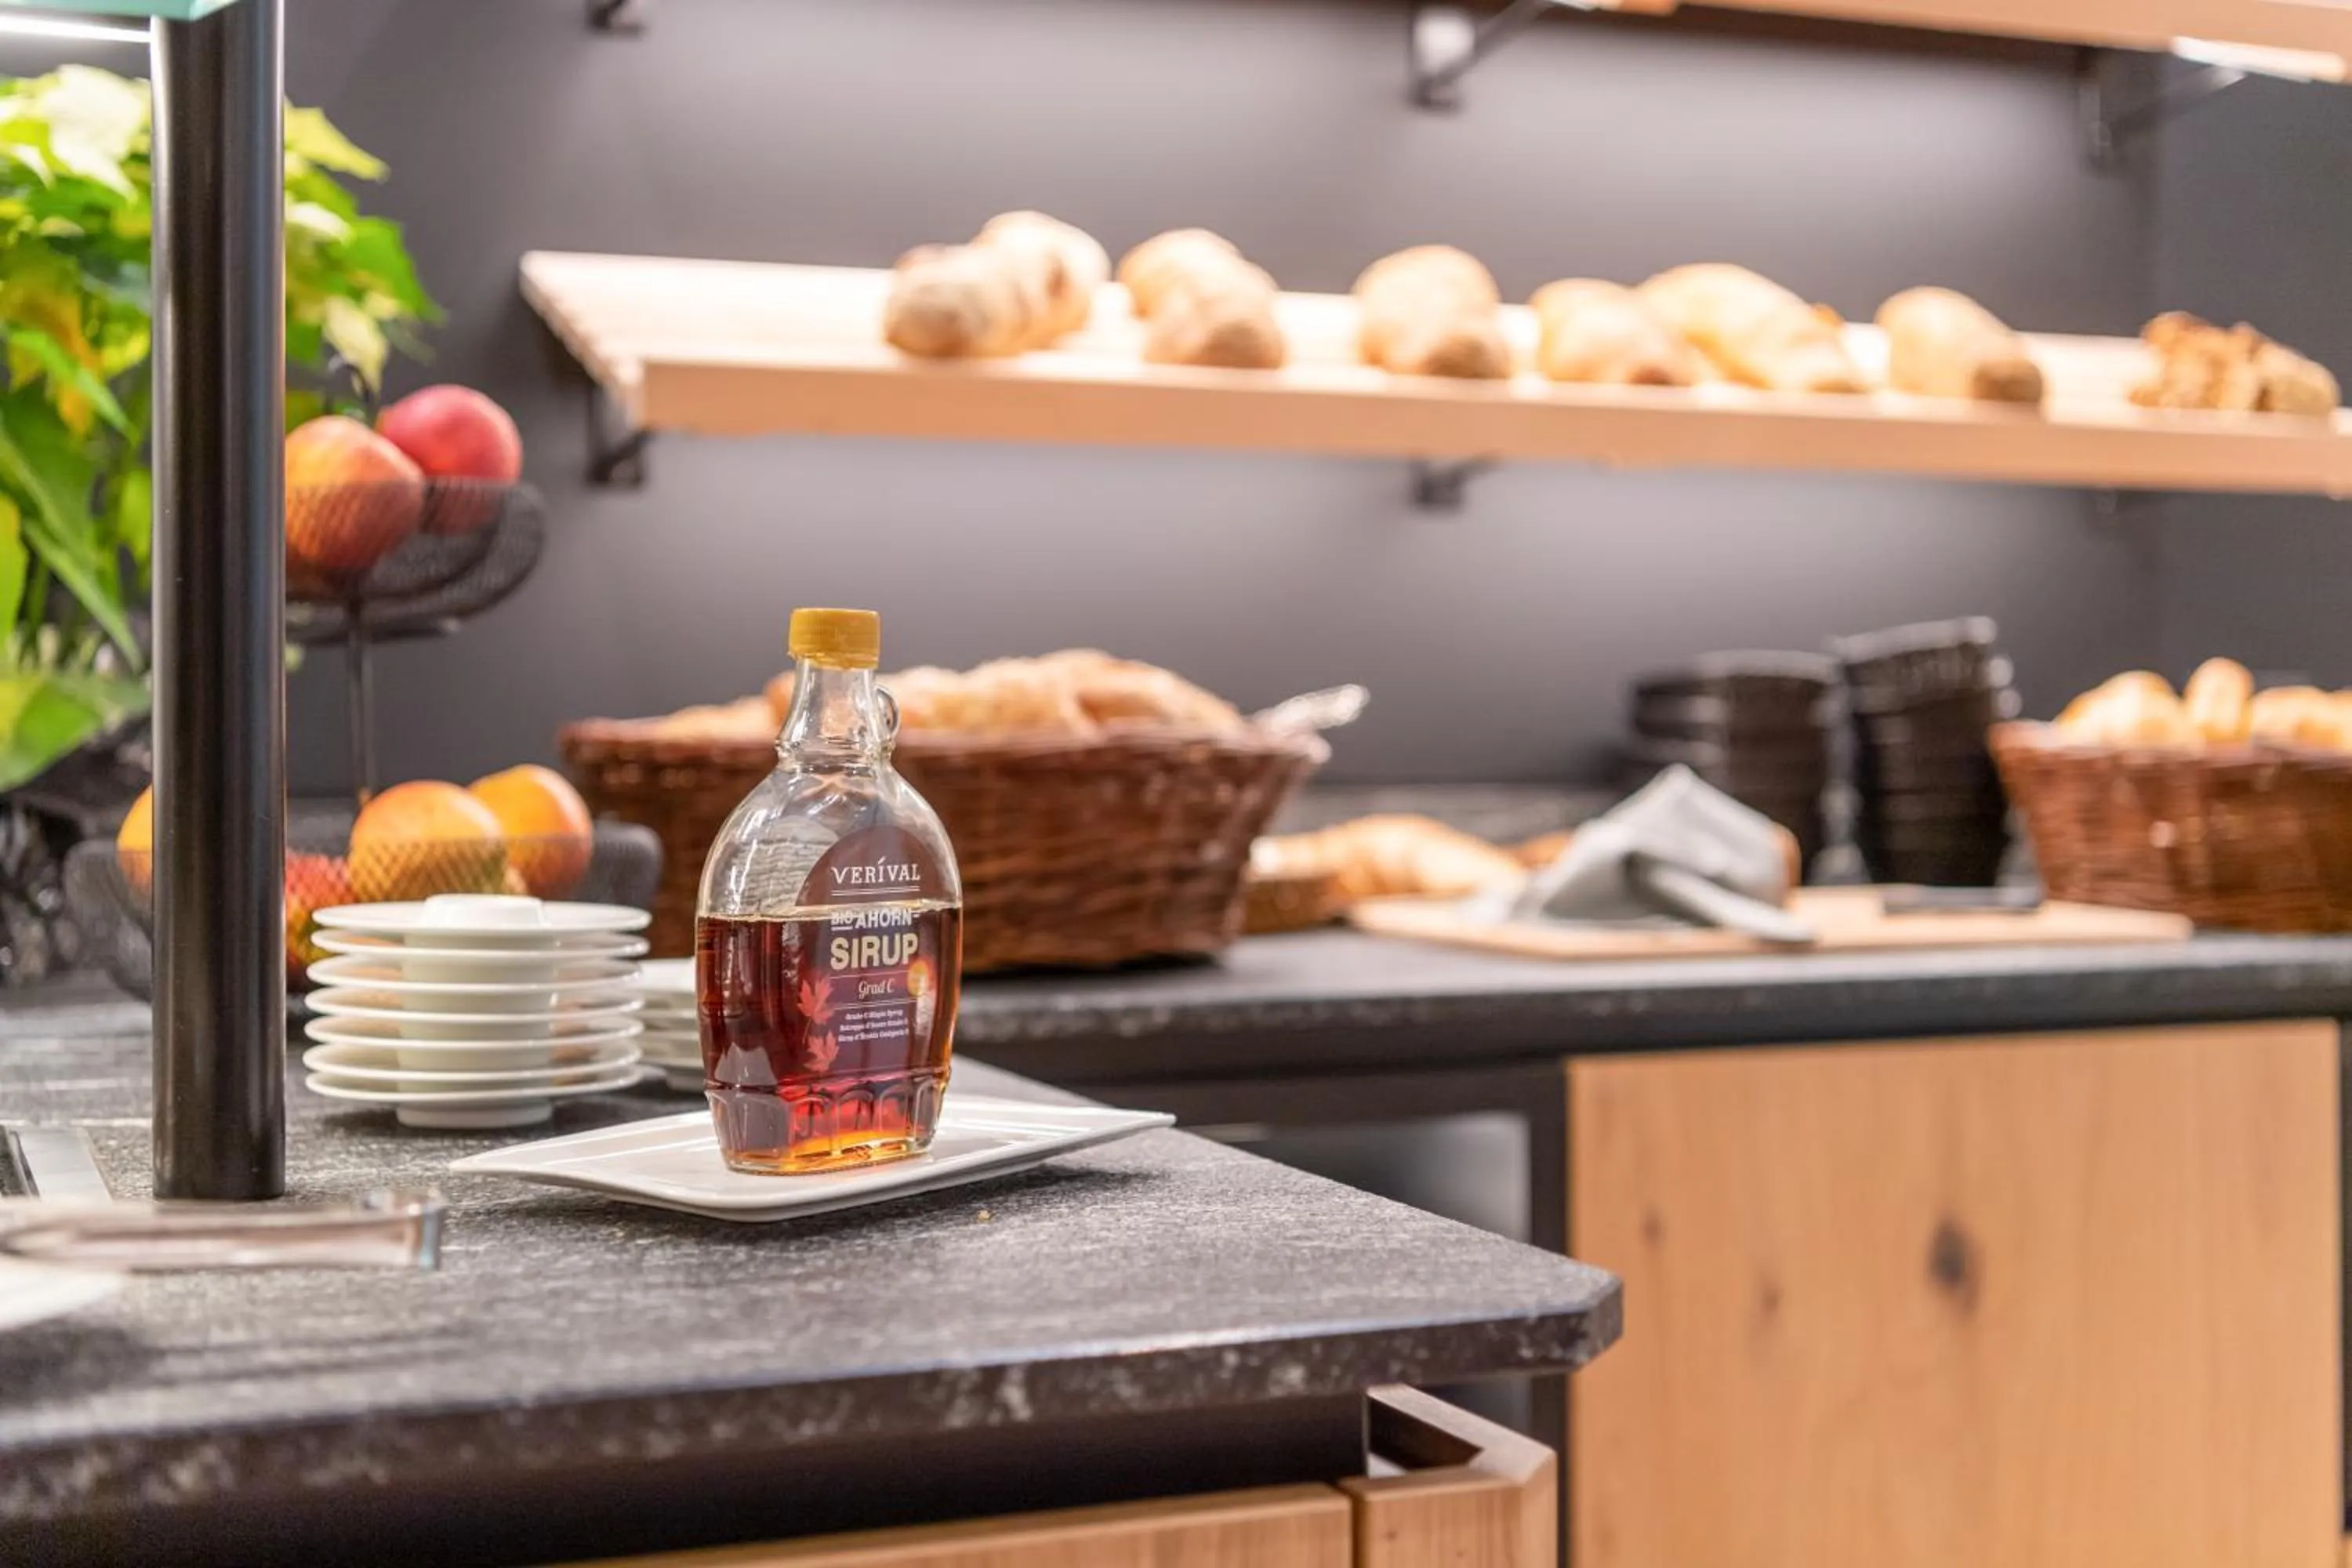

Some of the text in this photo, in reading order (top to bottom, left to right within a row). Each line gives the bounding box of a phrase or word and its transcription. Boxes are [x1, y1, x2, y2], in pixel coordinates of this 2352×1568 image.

[830, 932, 918, 970] SIRUP
[858, 978, 895, 999] Grad C
